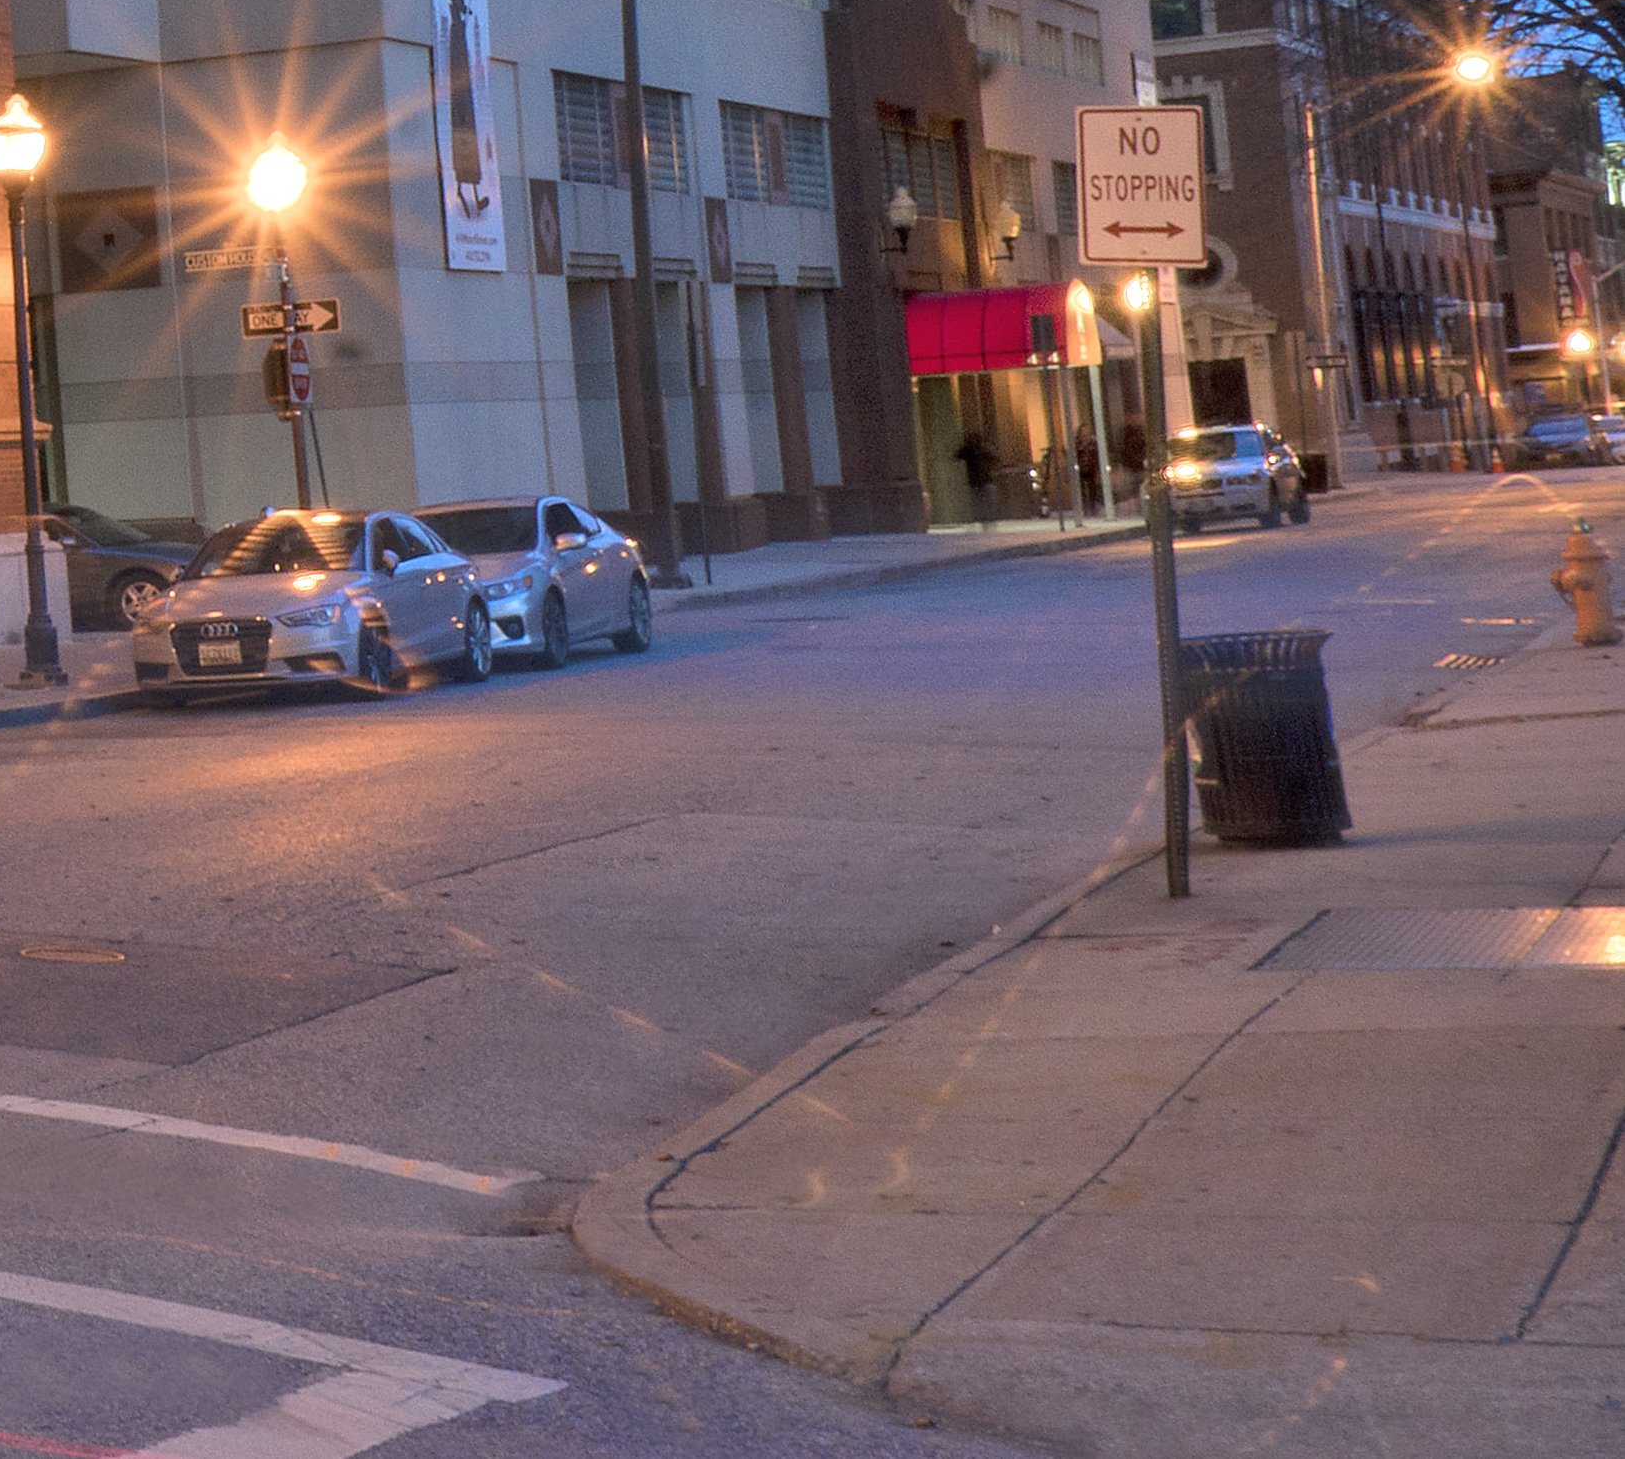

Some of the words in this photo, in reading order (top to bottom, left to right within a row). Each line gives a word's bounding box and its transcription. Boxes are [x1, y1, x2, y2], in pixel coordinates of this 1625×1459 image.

[1118, 125, 1161, 155] NO
[1089, 173, 1196, 202] STOPPING
[251, 314, 279, 329] ONE
